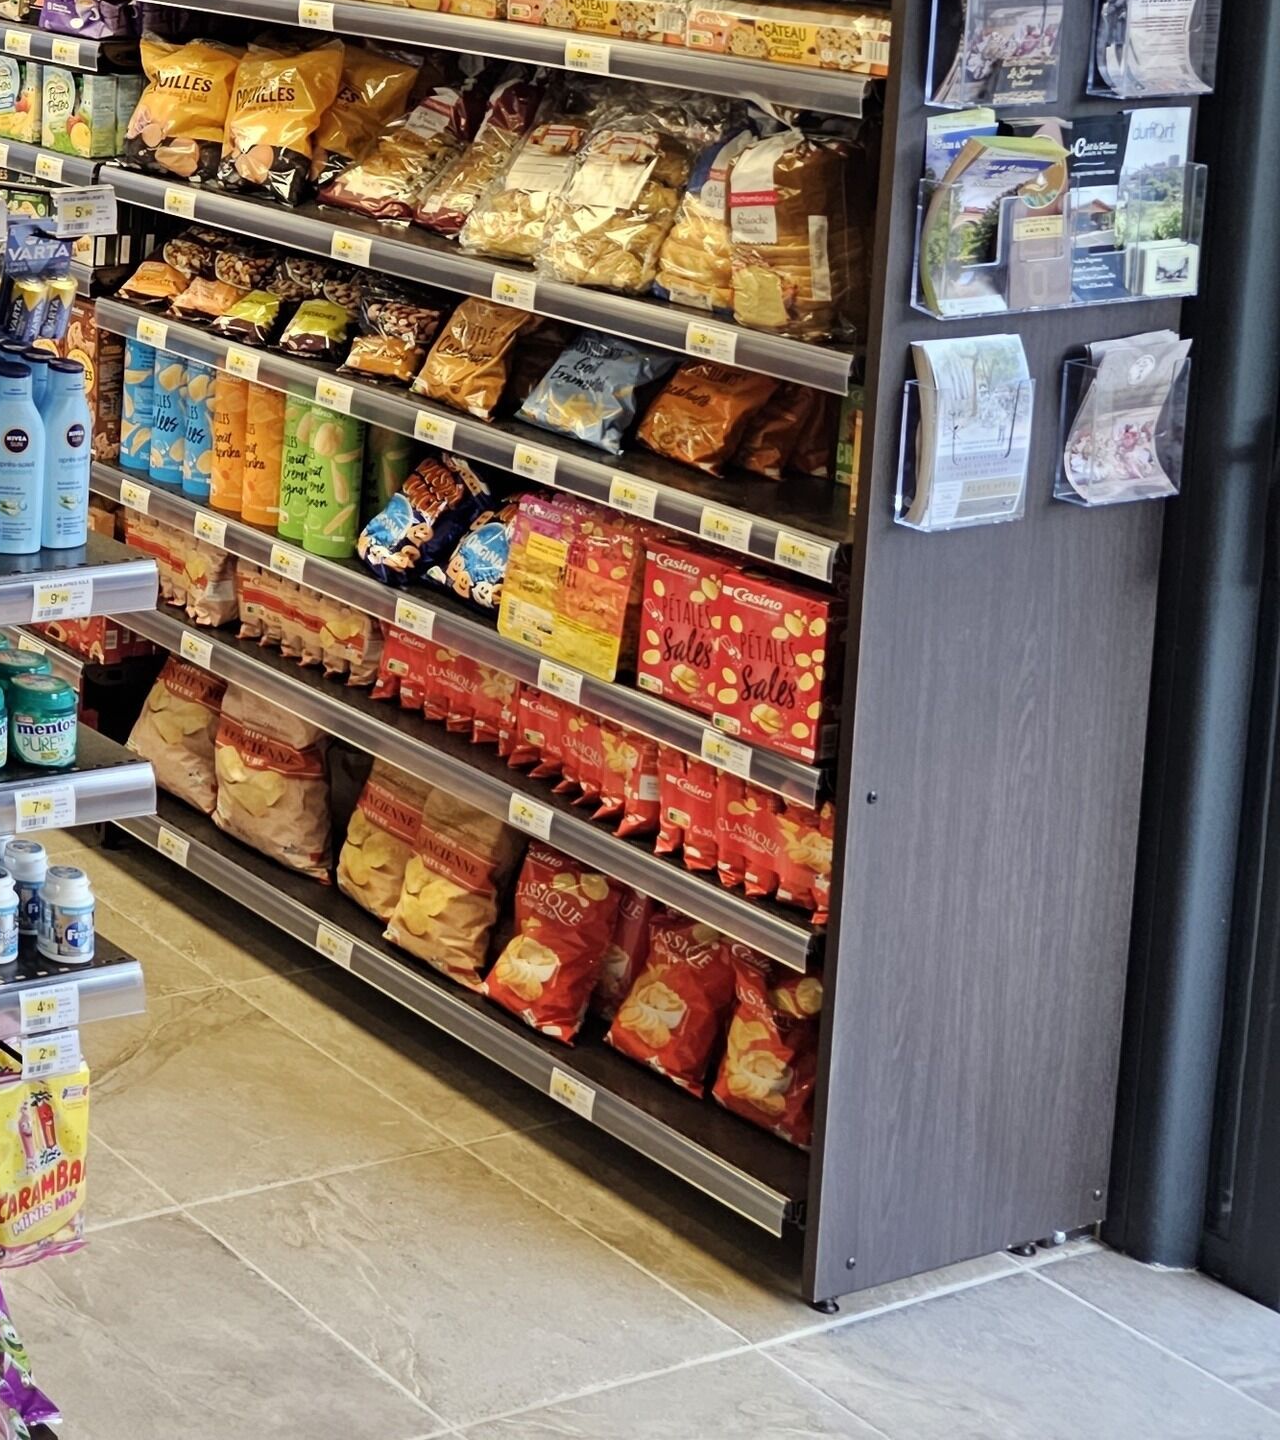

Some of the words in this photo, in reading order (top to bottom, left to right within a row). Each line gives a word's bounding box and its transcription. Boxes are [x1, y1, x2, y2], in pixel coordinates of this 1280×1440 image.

[8, 244, 70, 262] VARTA
[8, 299, 24, 334] VARTA
[656, 552, 701, 576] Casino
[661, 593, 713, 630] PÉTALES
[733, 587, 784, 612] Casino
[662, 626, 714, 670] Salés
[740, 632, 796, 667] PÉTALES
[741, 667, 797, 709] Salés
[16, 719, 75, 736] mentos
[22, 736, 57, 754] PURE
[676, 777, 713, 800] Casino
